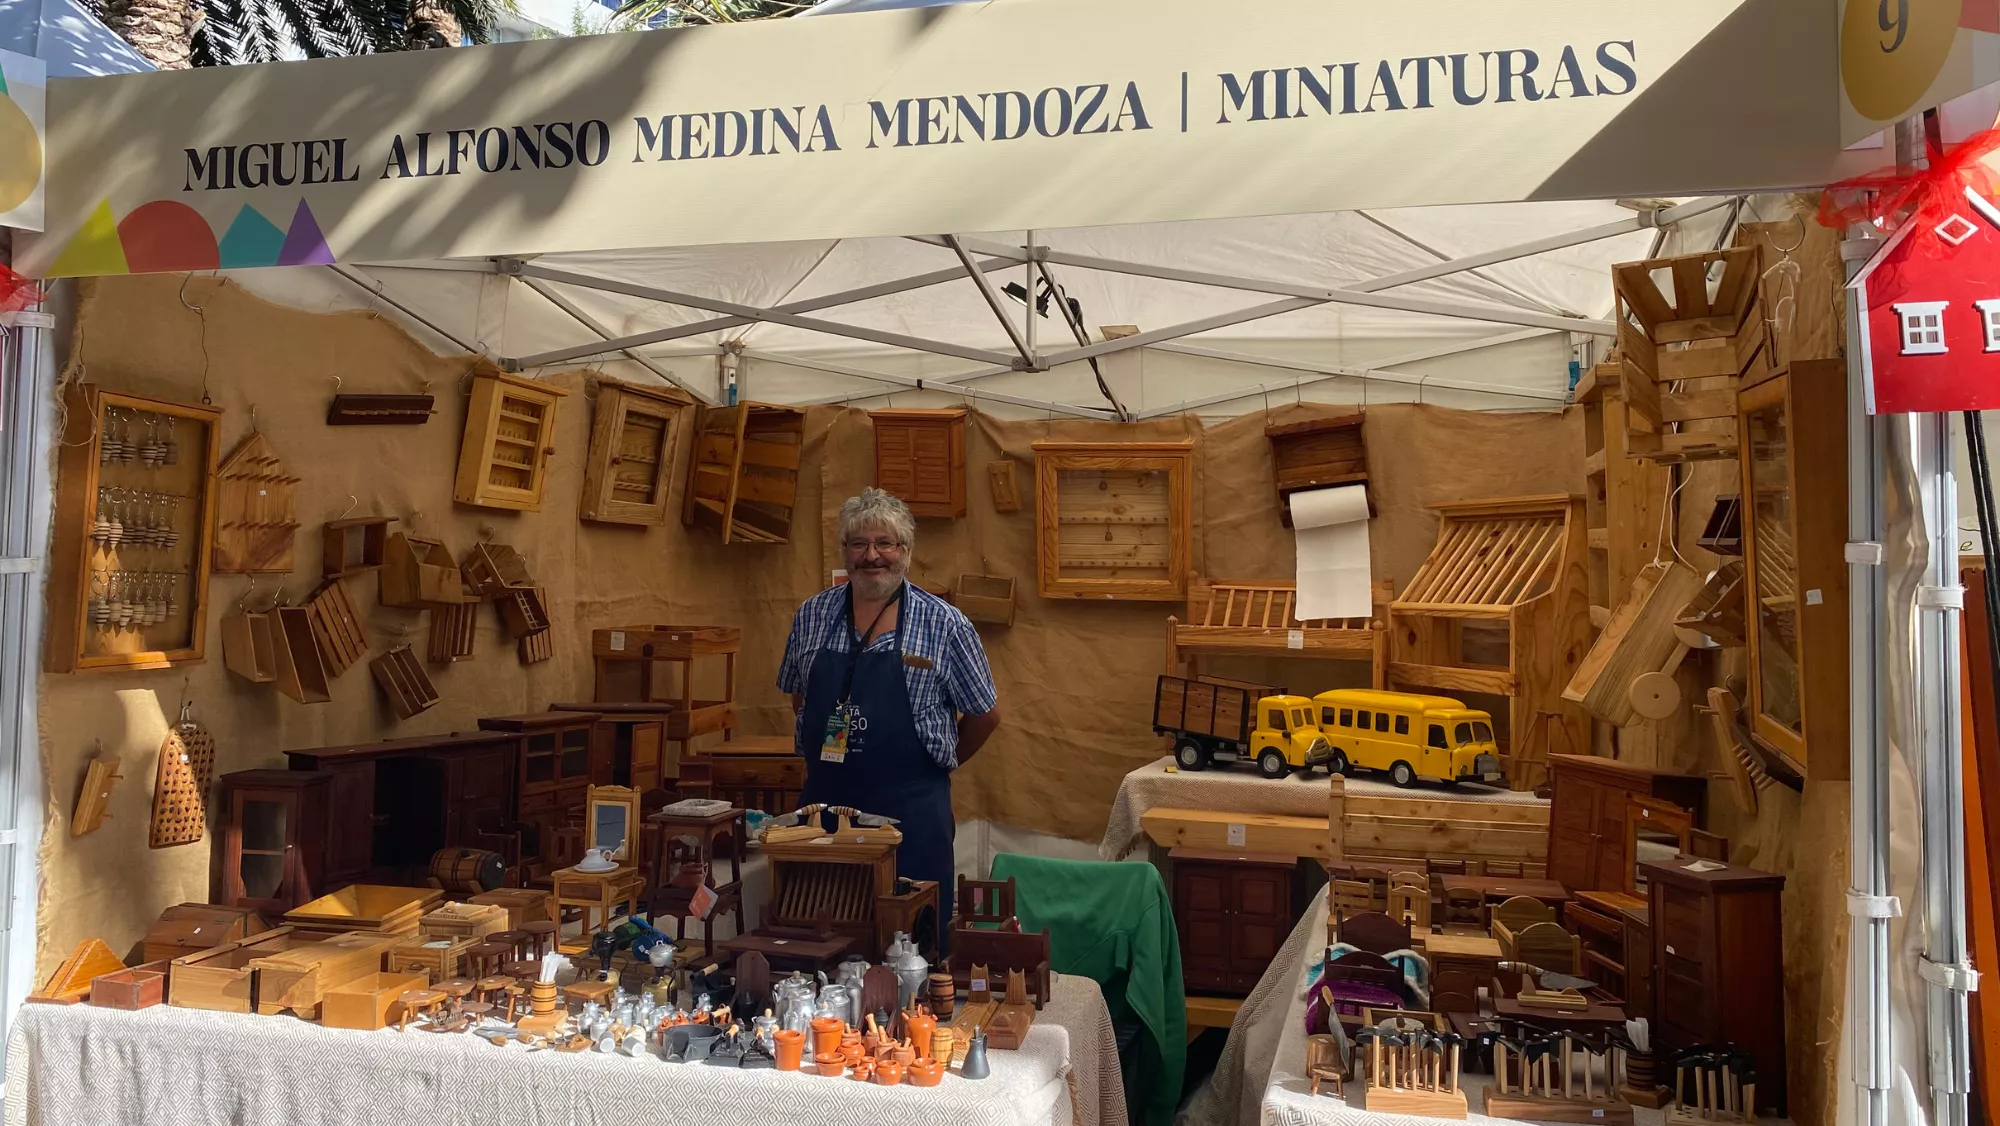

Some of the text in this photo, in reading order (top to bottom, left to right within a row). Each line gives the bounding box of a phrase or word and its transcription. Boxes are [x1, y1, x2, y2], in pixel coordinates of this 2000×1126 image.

[183, 138, 360, 191] MIGUEL
[379, 120, 609, 179] ALFONSO
[633, 105, 841, 162] MEDINA
[866, 82, 1153, 148] MENDOZA
[1217, 40, 1636, 123] MINIATURAS
